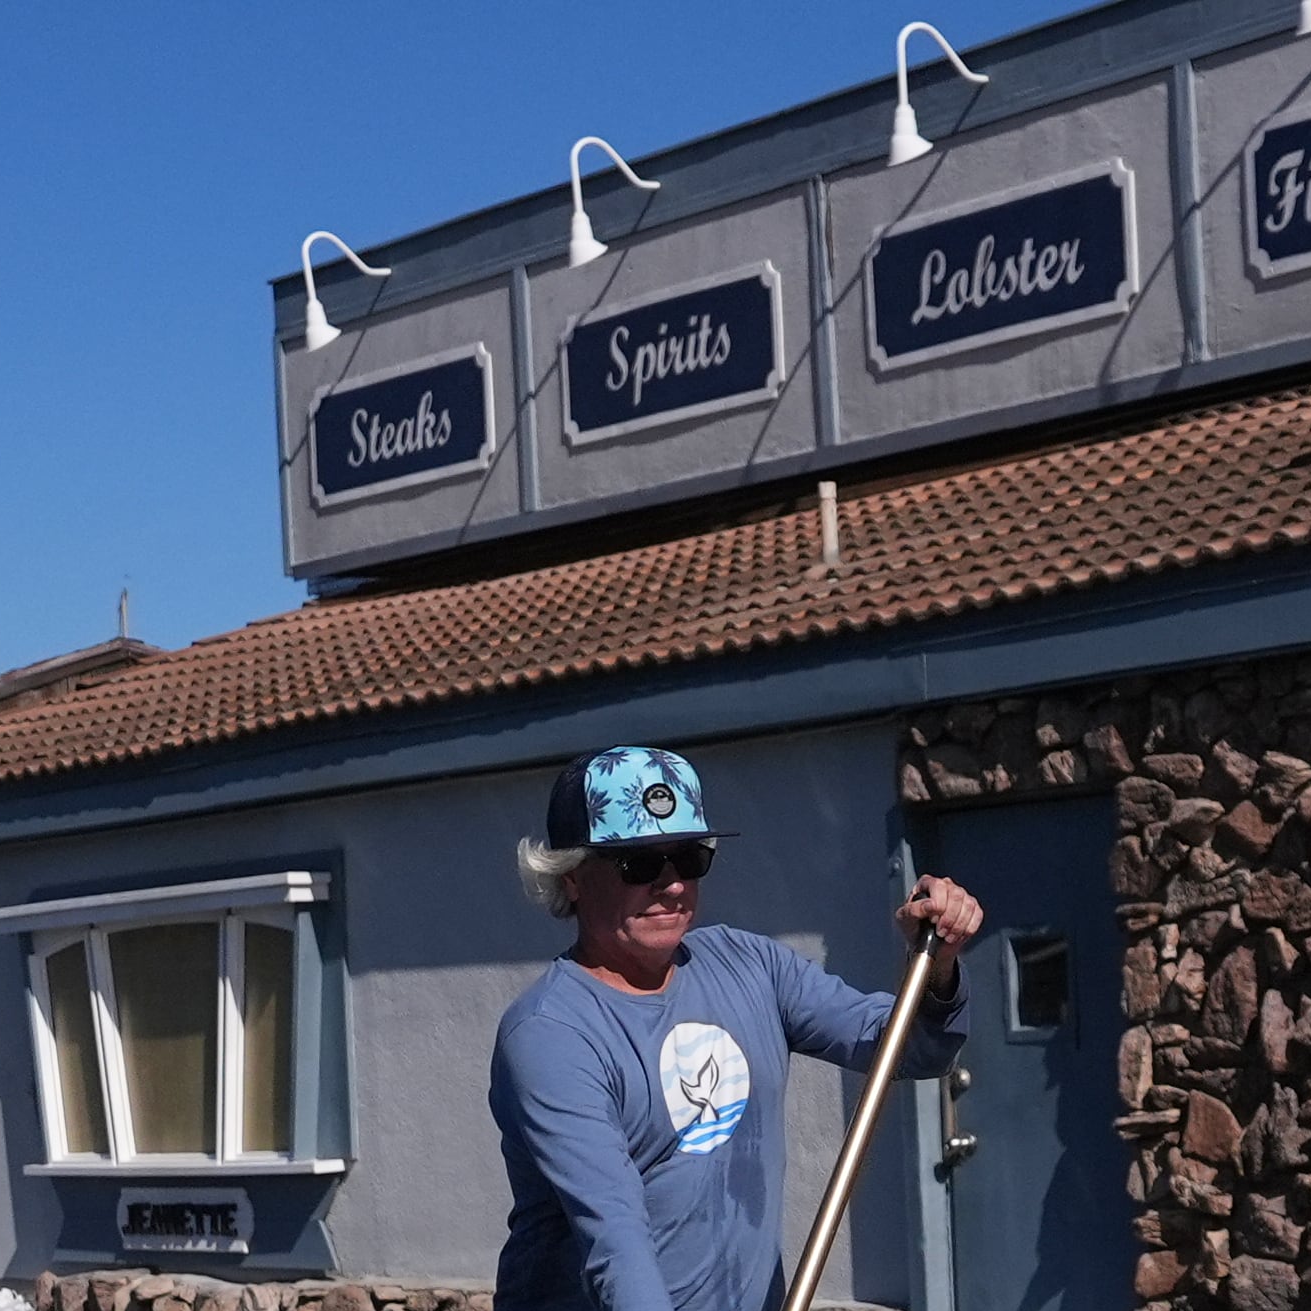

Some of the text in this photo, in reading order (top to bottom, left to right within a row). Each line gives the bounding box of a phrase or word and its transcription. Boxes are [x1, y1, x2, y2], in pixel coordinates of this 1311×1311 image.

[911, 234, 1085, 326] Lobster
[606, 311, 731, 407] Spirits
[346, 389, 452, 468] Steaks
